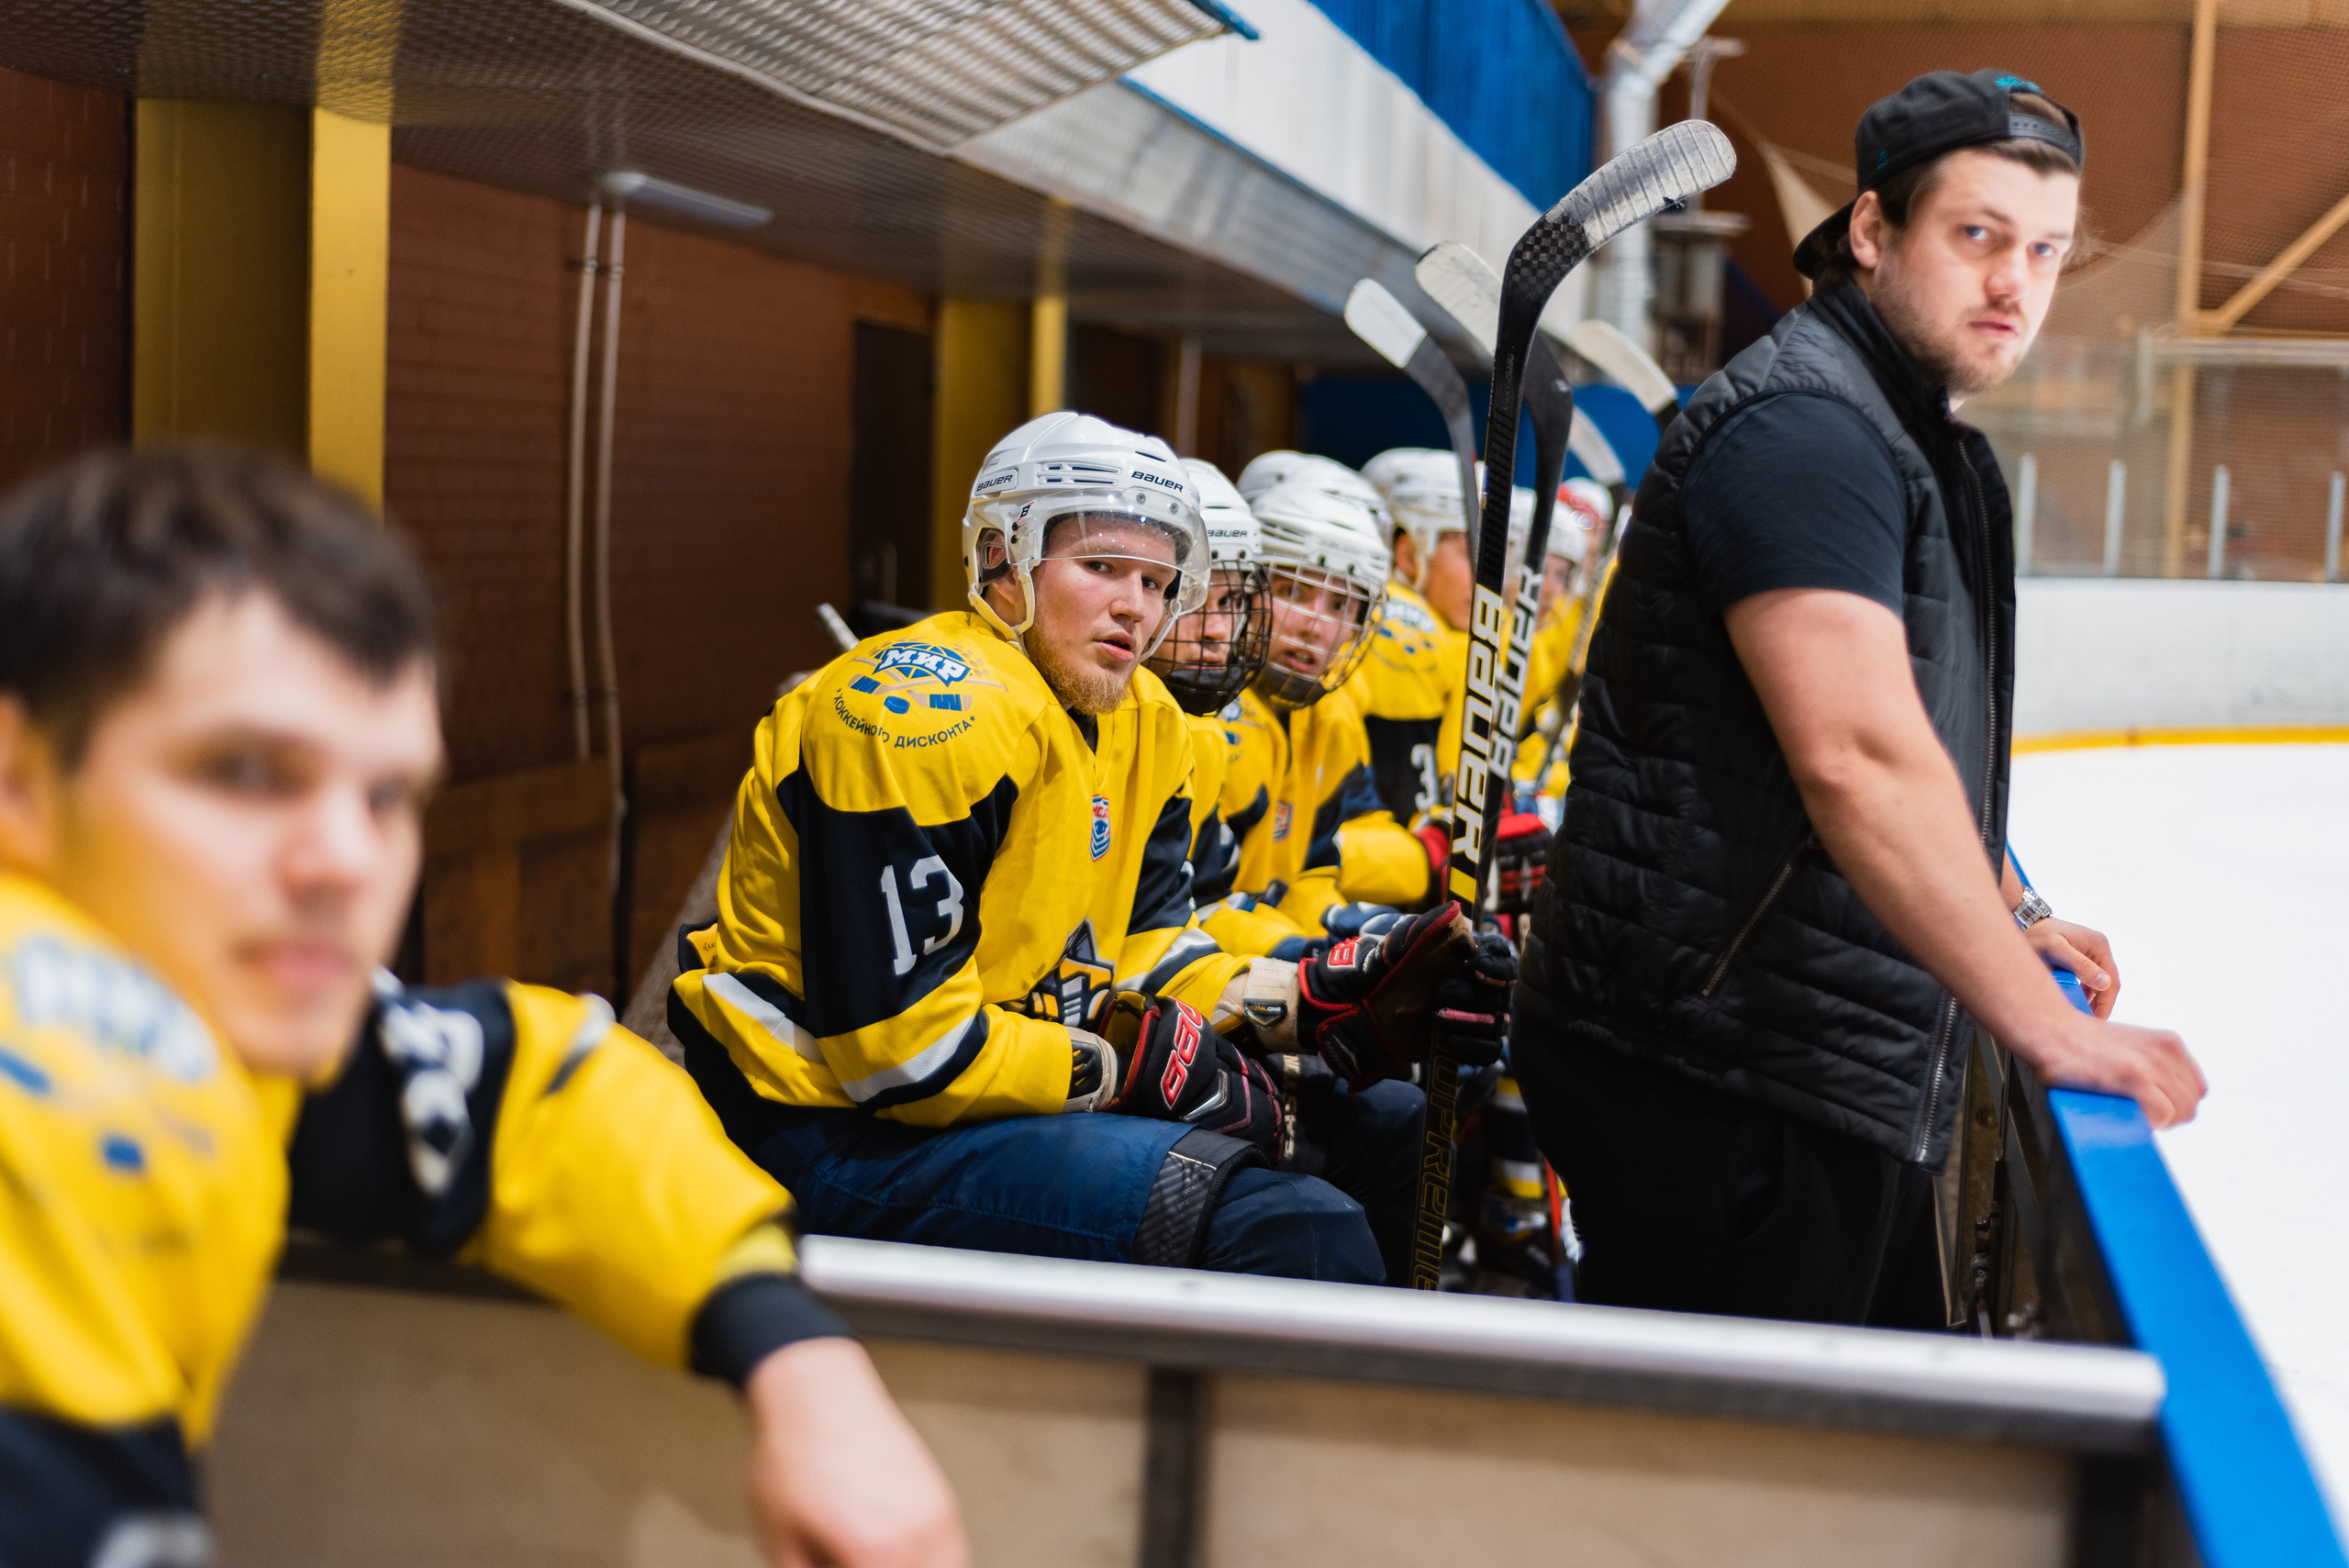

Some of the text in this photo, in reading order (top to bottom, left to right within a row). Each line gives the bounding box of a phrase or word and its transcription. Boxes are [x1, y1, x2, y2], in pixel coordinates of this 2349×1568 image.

[976, 474, 1014, 492] BAUER
[1130, 471, 1184, 493] BAUER
[1208, 529, 1248, 538] BAUER
[878, 649, 967, 681] МИР
[1488, 564, 1543, 780] BAUER
[895, 719, 972, 749] ДИСКОНТА
[1452, 583, 1503, 863] BAUER
[880, 854, 964, 976] 13
[1413, 1029, 1460, 1293] UPREME
